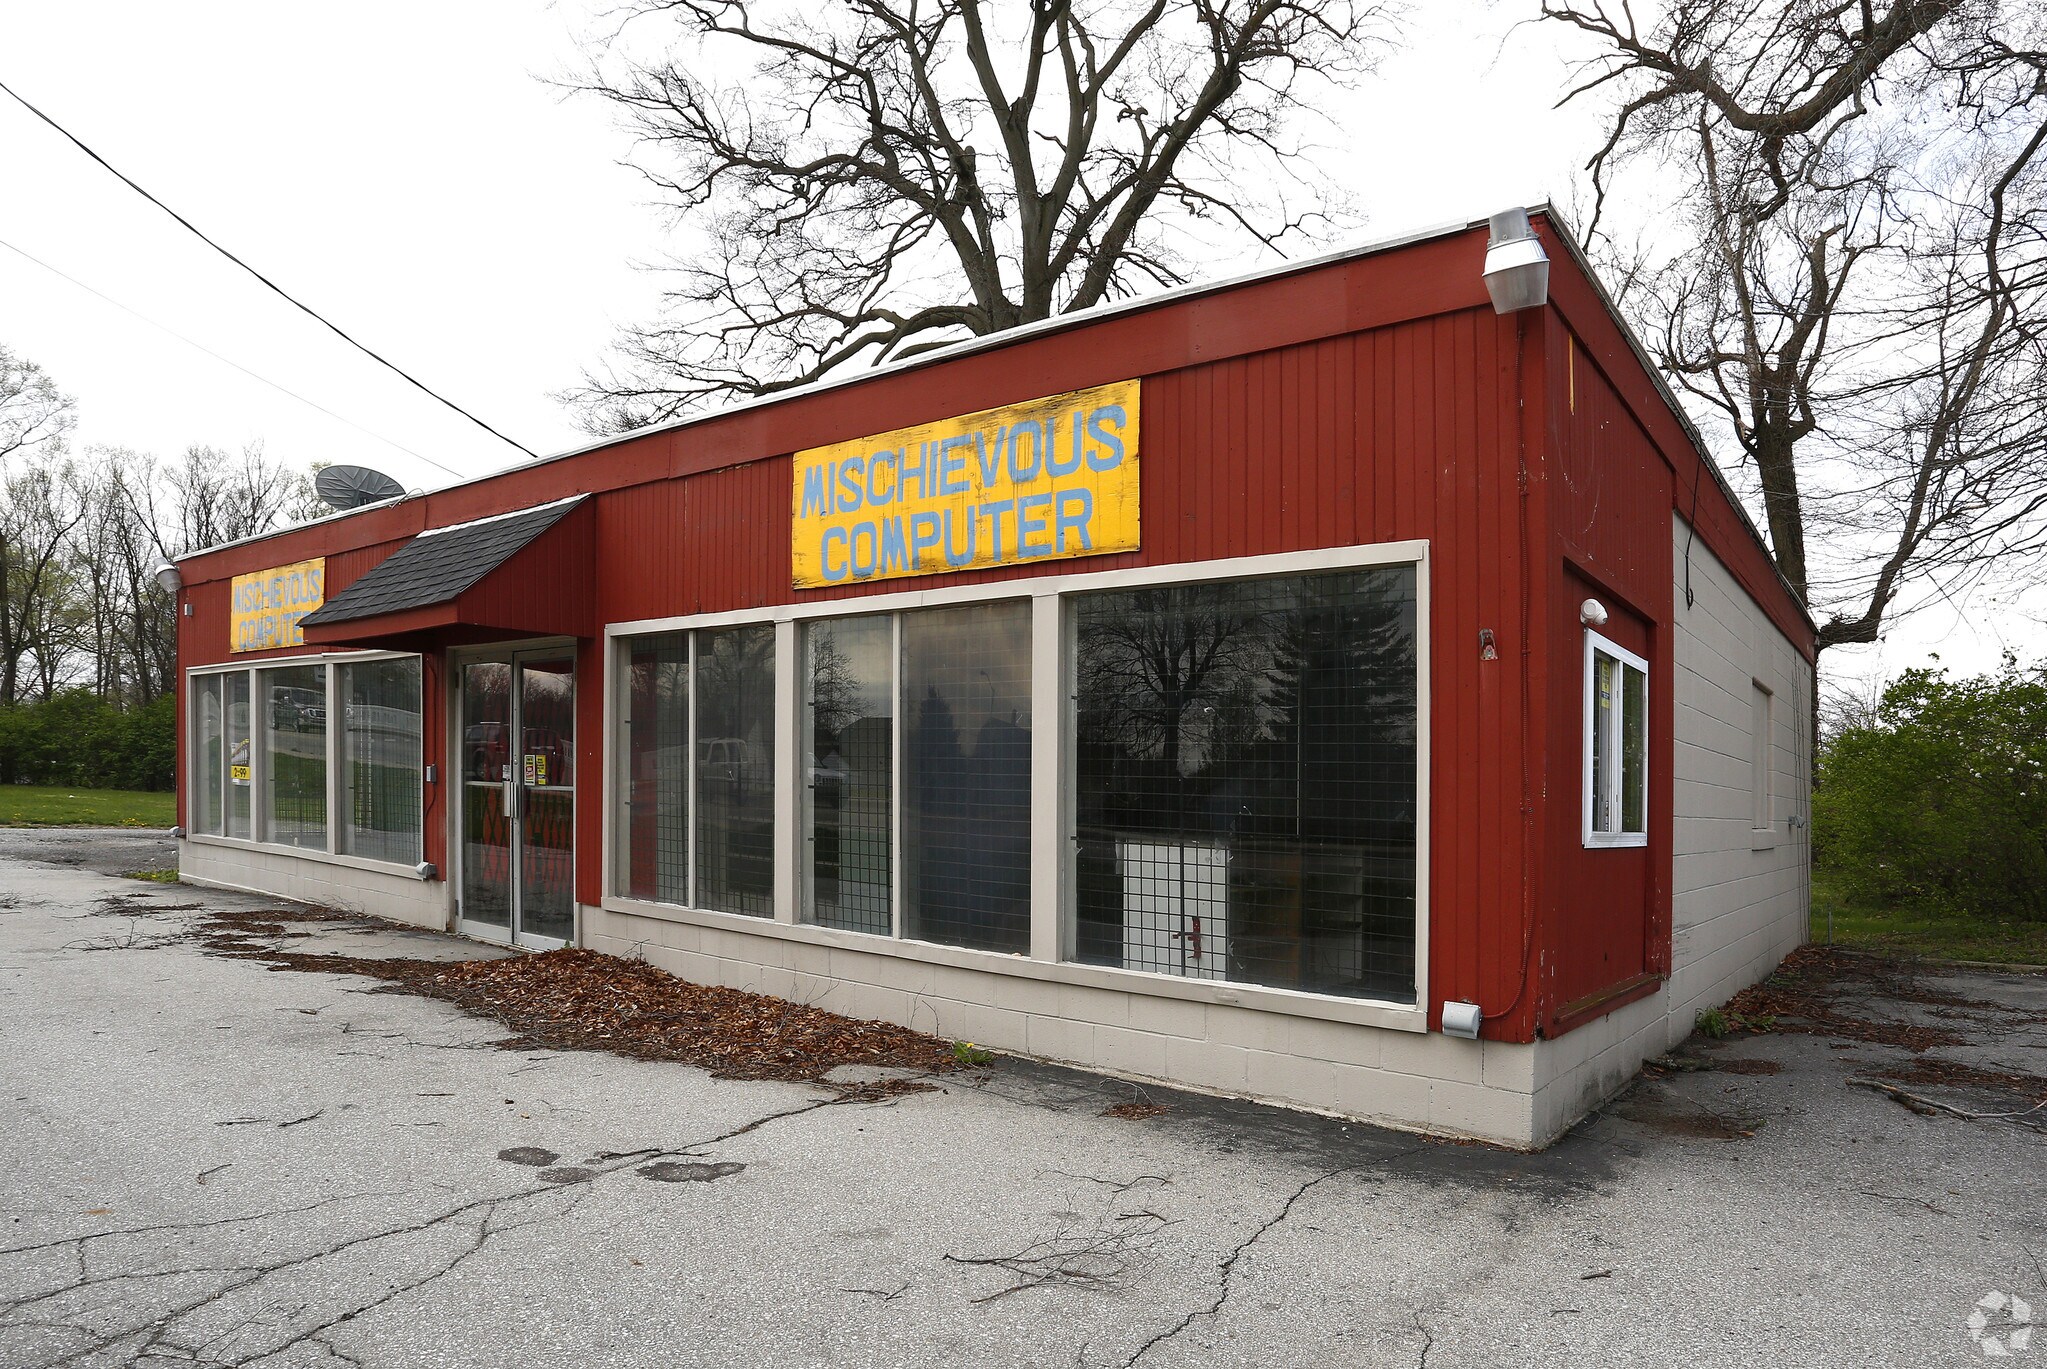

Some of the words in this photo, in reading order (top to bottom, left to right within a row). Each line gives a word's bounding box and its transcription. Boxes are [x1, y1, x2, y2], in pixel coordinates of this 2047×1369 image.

[800, 404, 1127, 520] MISCHIEVOUS
[820, 487, 1094, 581] COMPUTER
[233, 568, 321, 615] MISCHIEVOUS
[239, 611, 311, 649] COMPUTE
